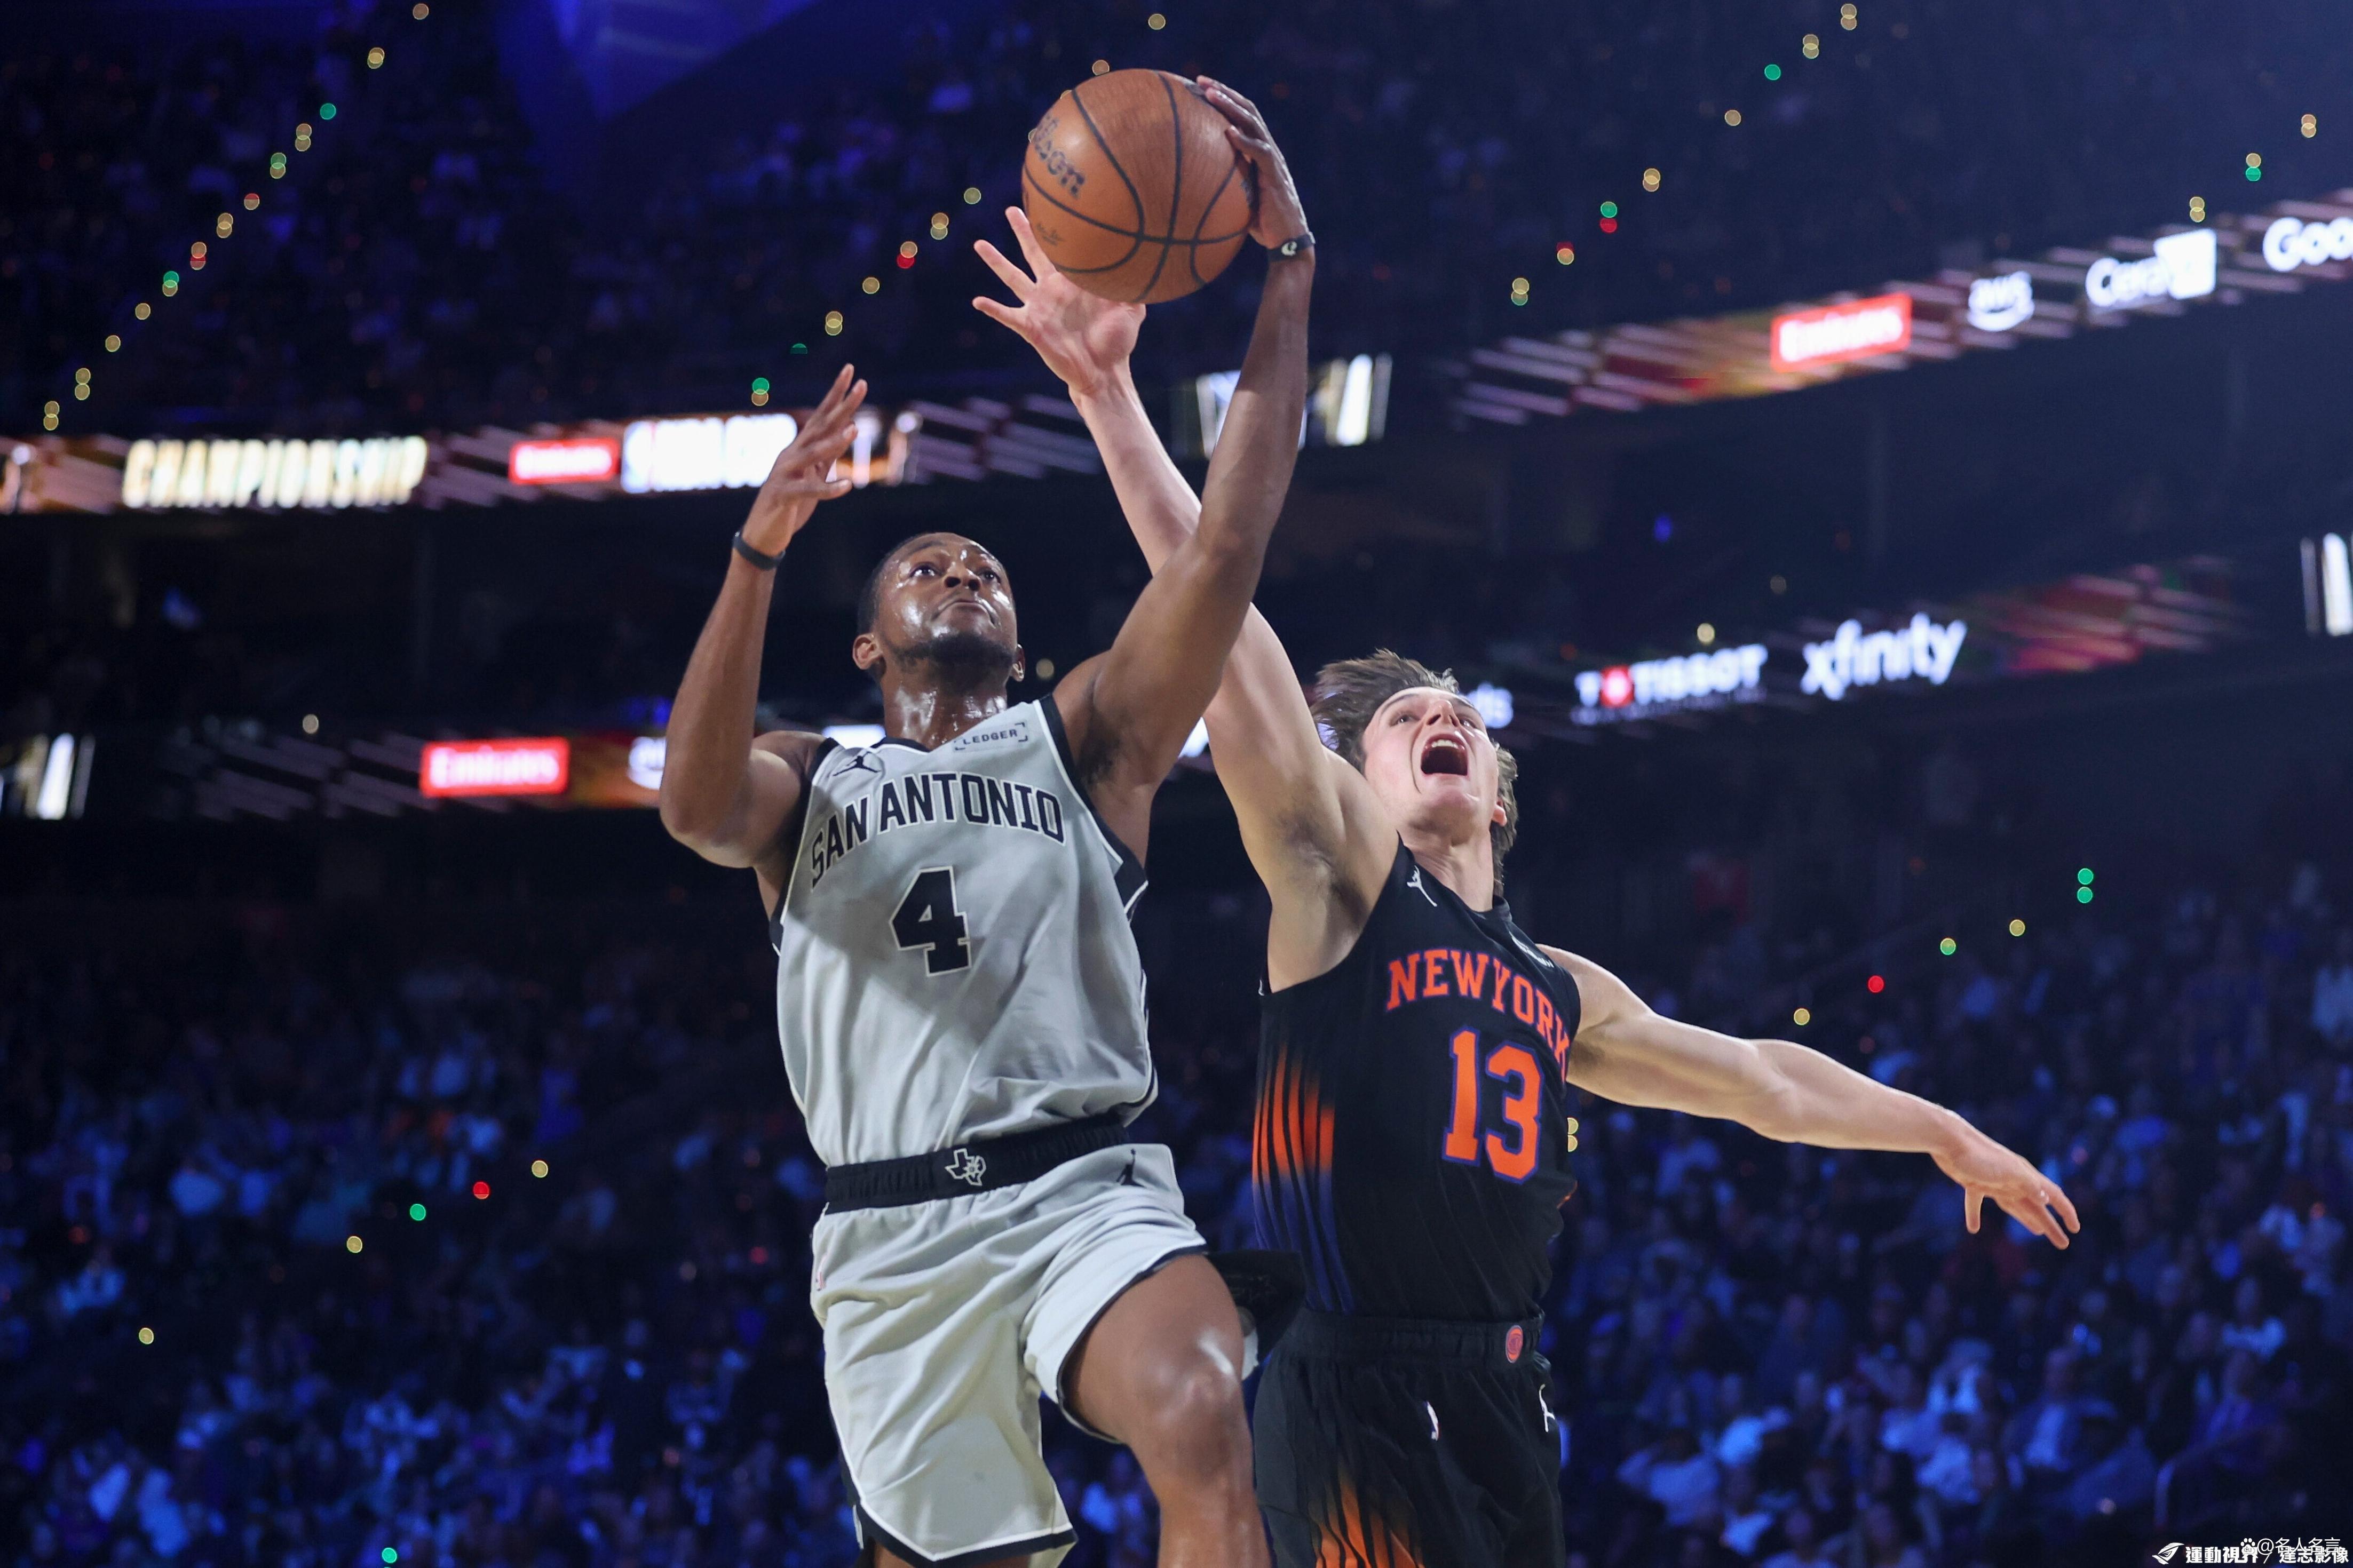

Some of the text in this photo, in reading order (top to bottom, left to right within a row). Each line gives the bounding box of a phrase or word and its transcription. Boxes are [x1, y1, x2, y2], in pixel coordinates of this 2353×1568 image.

[1800, 612, 1967, 701] xfinity
[963, 729, 1017, 745] LEDGER
[812, 771, 1066, 891] SAN ANTONIO
[889, 866, 971, 977] 4
[1386, 948, 1490, 1012] NEW
[1443, 1025, 1544, 1185] 13
